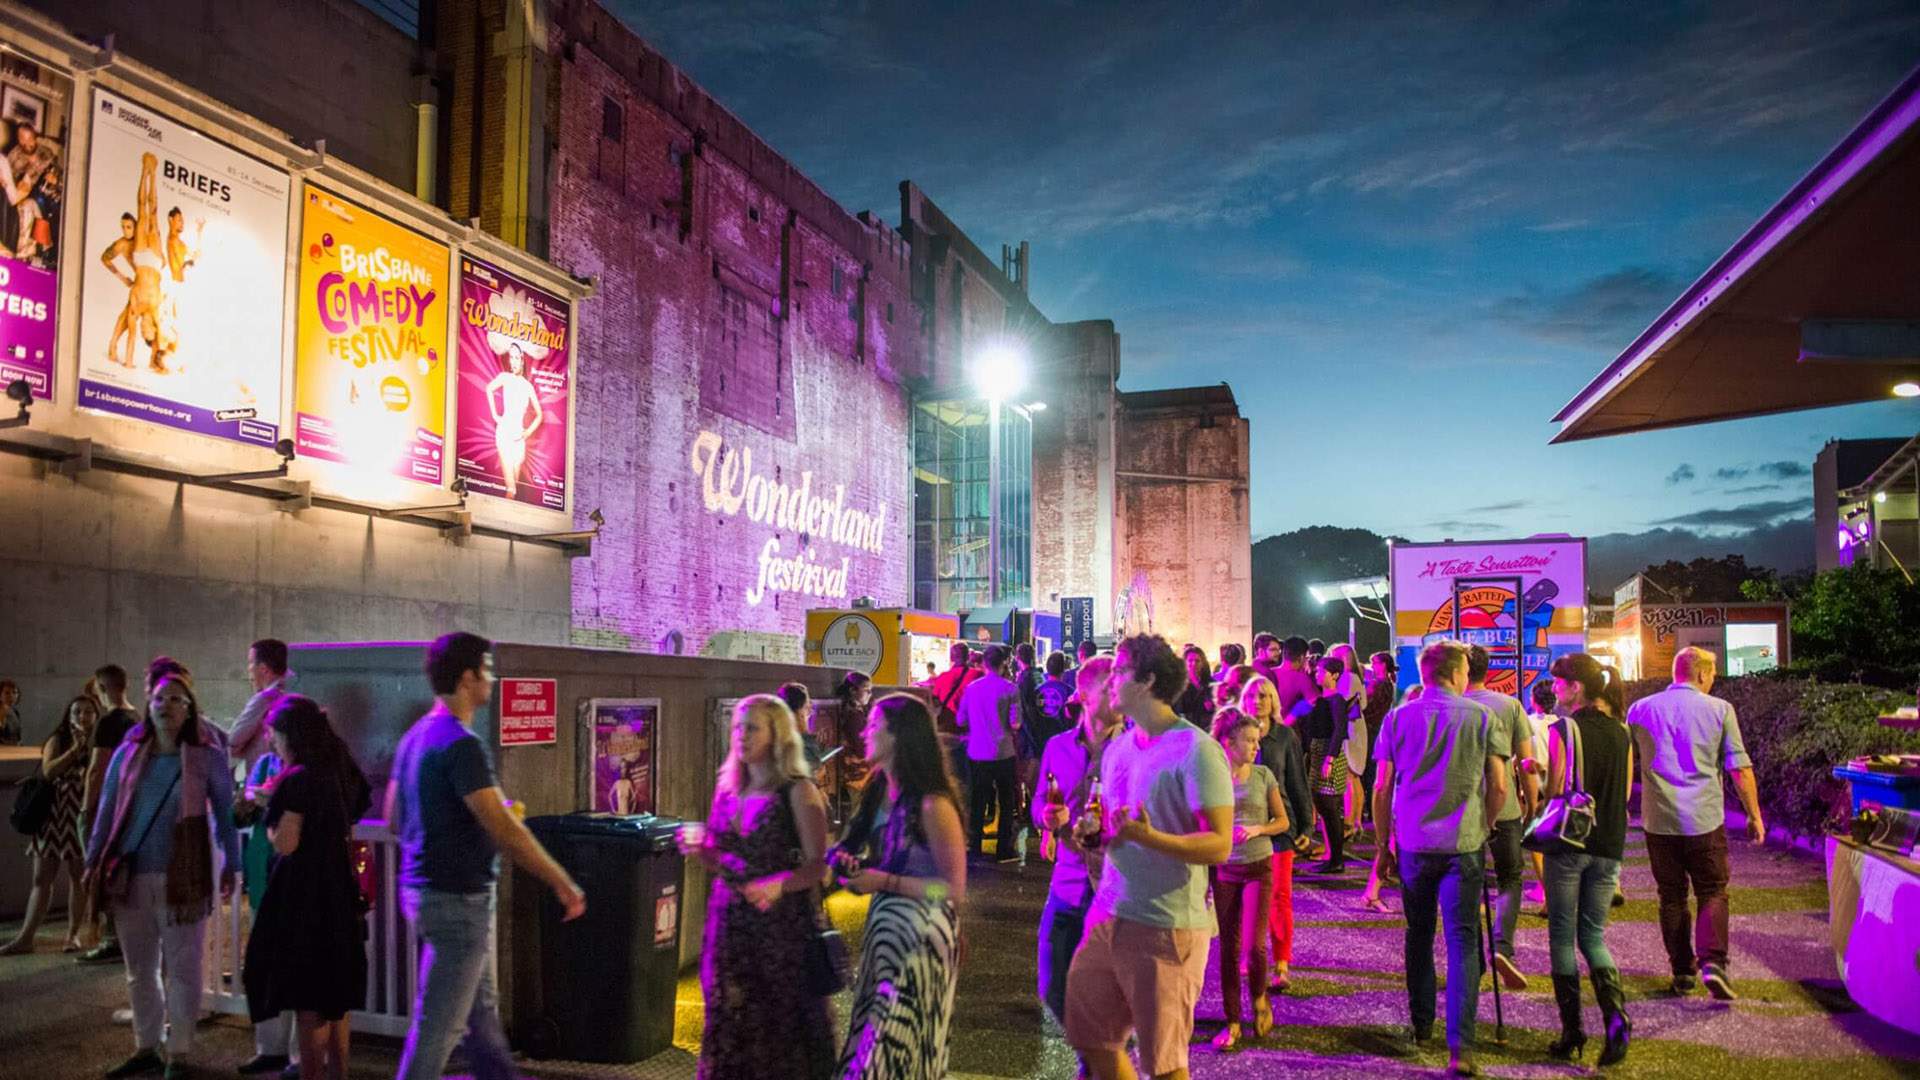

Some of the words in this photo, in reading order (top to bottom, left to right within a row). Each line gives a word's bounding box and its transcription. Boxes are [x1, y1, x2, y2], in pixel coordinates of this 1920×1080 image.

[163, 159, 231, 202] BRIEFS
[339, 244, 432, 286] BRISBANE
[317, 271, 436, 334] COMEDY
[463, 298, 566, 351] Wonderland
[327, 325, 426, 368] FESTIVAL
[691, 429, 887, 556] Wonderland
[747, 538, 850, 605] festival
[1440, 559, 1475, 575] Taste
[1082, 600, 1092, 642] ransport
[1643, 603, 1686, 625] viva
[827, 647, 854, 656] LITTLE
